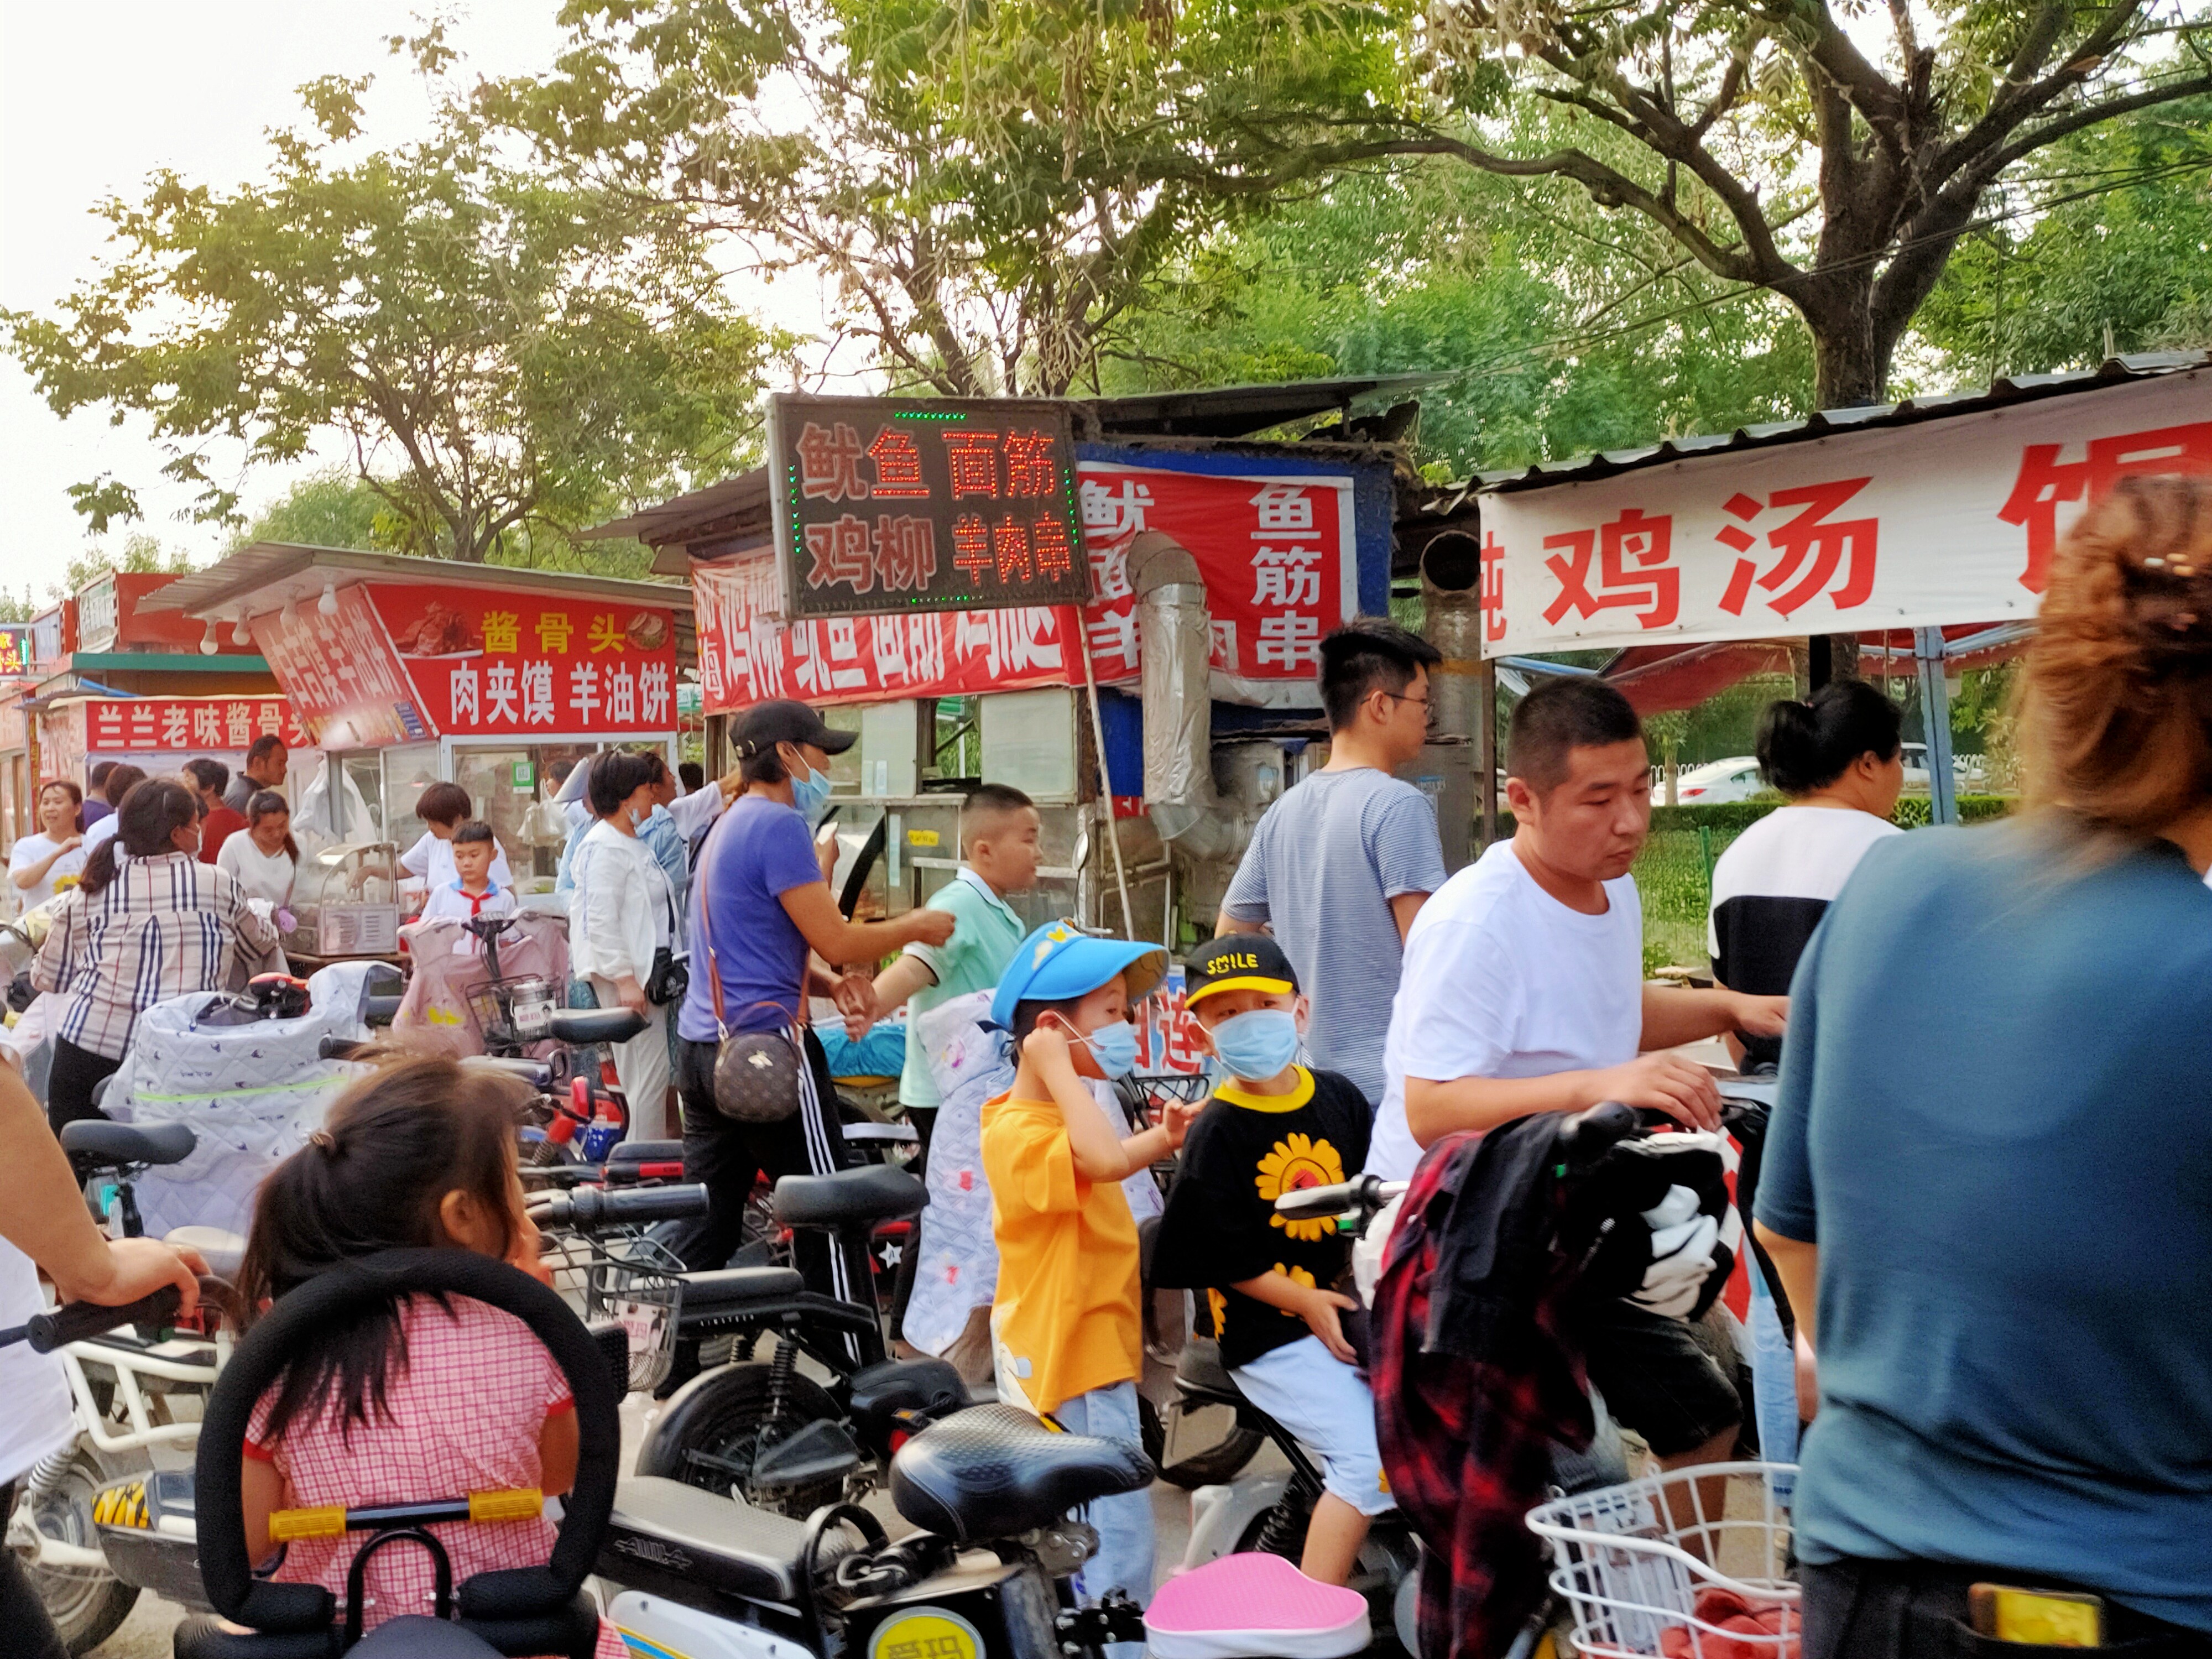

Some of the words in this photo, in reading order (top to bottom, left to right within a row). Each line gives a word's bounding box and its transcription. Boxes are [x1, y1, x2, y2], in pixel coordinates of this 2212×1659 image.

[796, 422, 931, 502] 鱿鱼
[941, 429, 1055, 499] 面筋
[805, 514, 937, 594] 鸡柳
[952, 510, 1073, 586] 羊肉串
[1542, 476, 1879, 629] 鸡汤
[481, 611, 626, 654] 酱骨头
[450, 659, 555, 726] 肉夹馍
[570, 661, 670, 726] 羊油饼
[1207, 952, 1259, 975] SMILE
